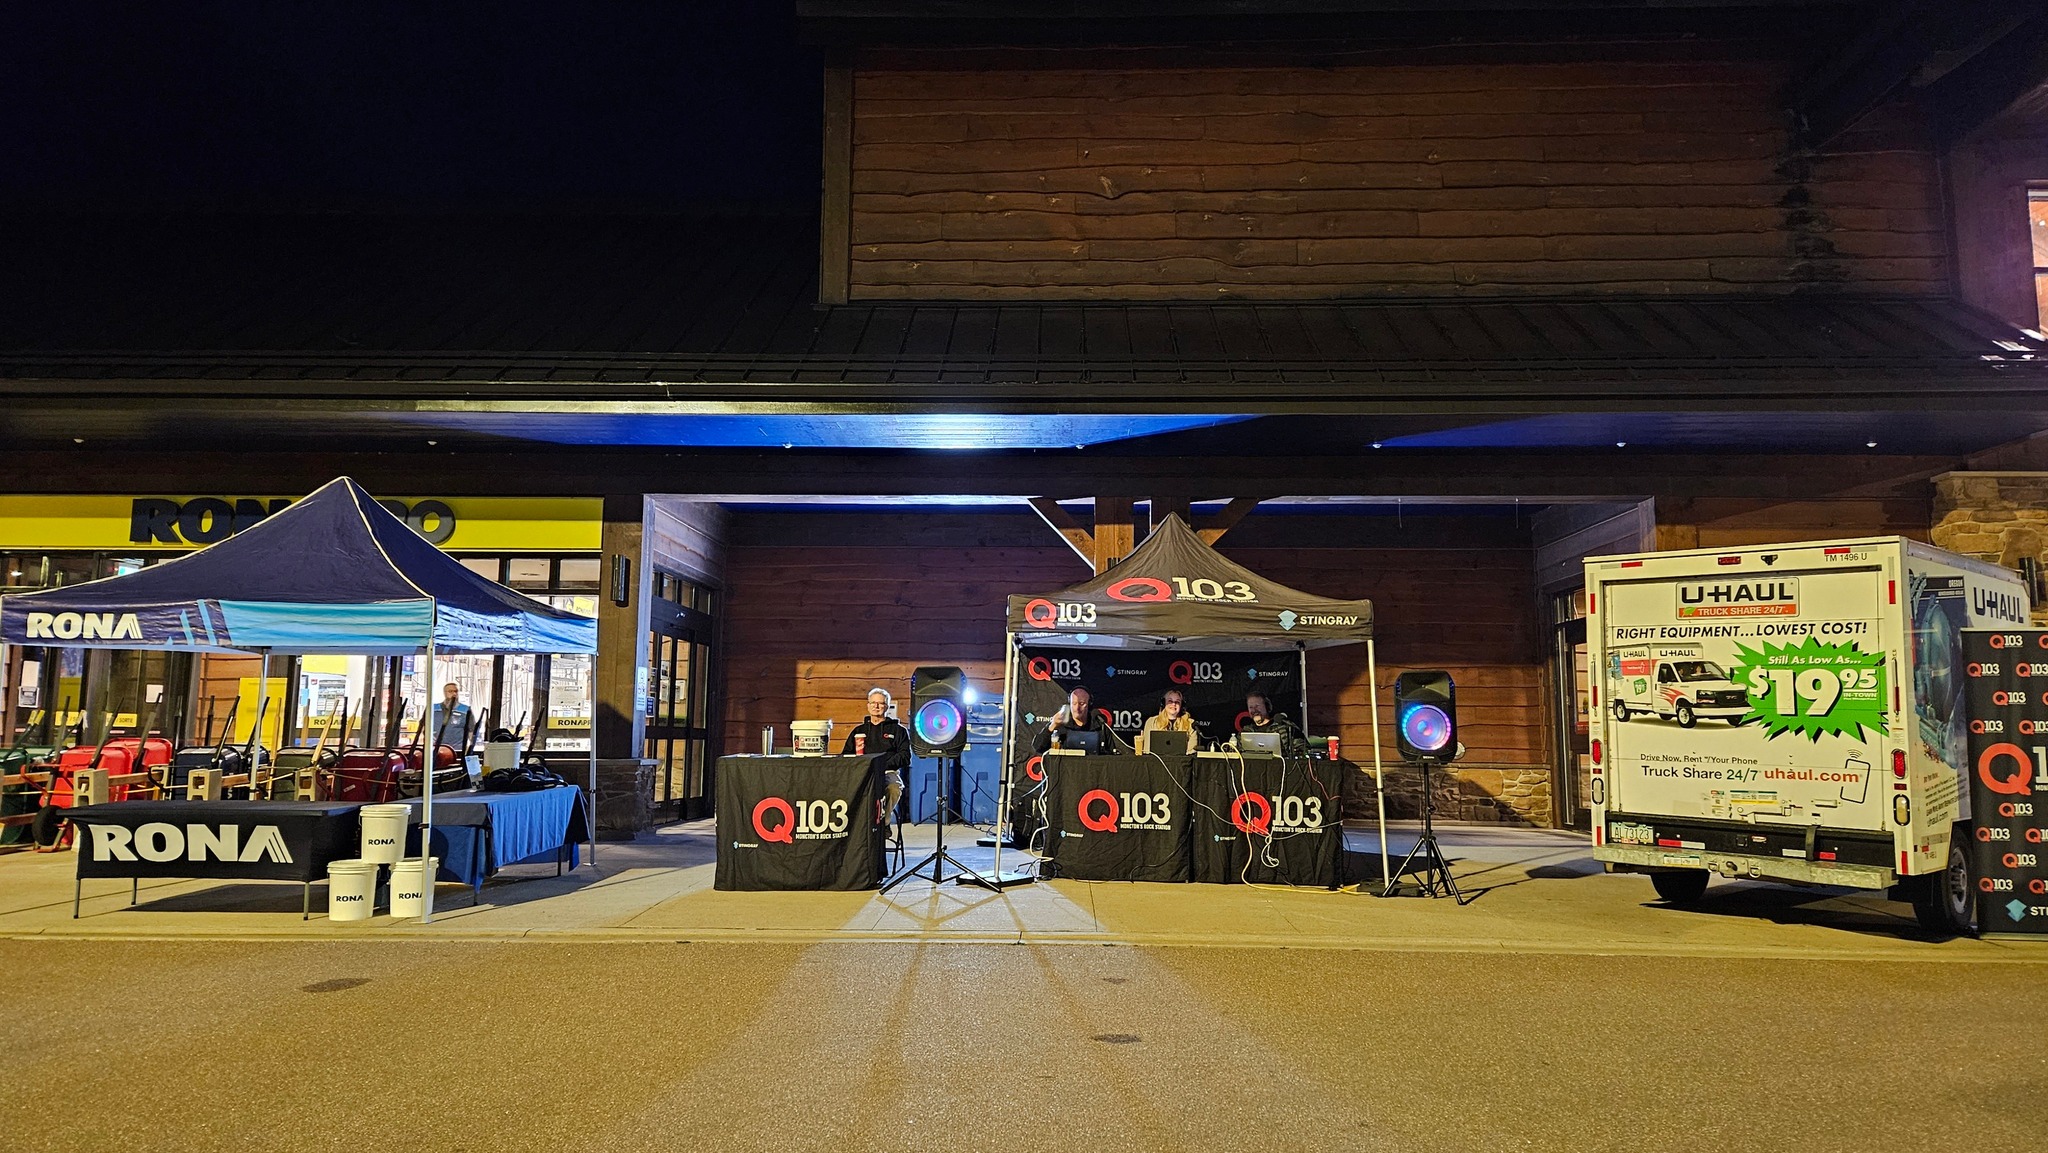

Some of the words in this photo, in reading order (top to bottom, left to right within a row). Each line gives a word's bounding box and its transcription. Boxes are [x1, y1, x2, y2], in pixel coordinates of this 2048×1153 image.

[130, 499, 291, 545] RON
[1825, 554, 1837, 562] TM
[1840, 553, 1858, 561] 1496
[1681, 583, 1794, 603] U-HAUL
[1698, 607, 1728, 616] TRUCK
[1730, 606, 1761, 615] SHARE
[1764, 605, 1783, 614] 24/7
[1974, 587, 2024, 624] U-HAUL
[26, 612, 143, 639] RONA
[1300, 616, 1358, 625] STINGRAY
[1616, 628, 1656, 639] RIGHT
[1821, 622, 1867, 634] COST!
[1768, 654, 1788, 665] Still
[1791, 656, 1806, 665] As
[1809, 656, 1832, 665] Low
[1836, 656, 1862, 665] As...
[1640, 754, 1661, 762] Drive
[1663, 755, 1682, 763] Now,
[1732, 757, 1758, 765] Phone
[1641, 766, 1679, 777] Truck
[1683, 767, 1722, 779] Share
[1727, 768, 1758, 783] 24/7
[1764, 769, 1859, 783] uhaul.com
[1978, 743, 2048, 796] Q1
[88, 822, 293, 864] RONA
[368, 838, 395, 846] RONA
